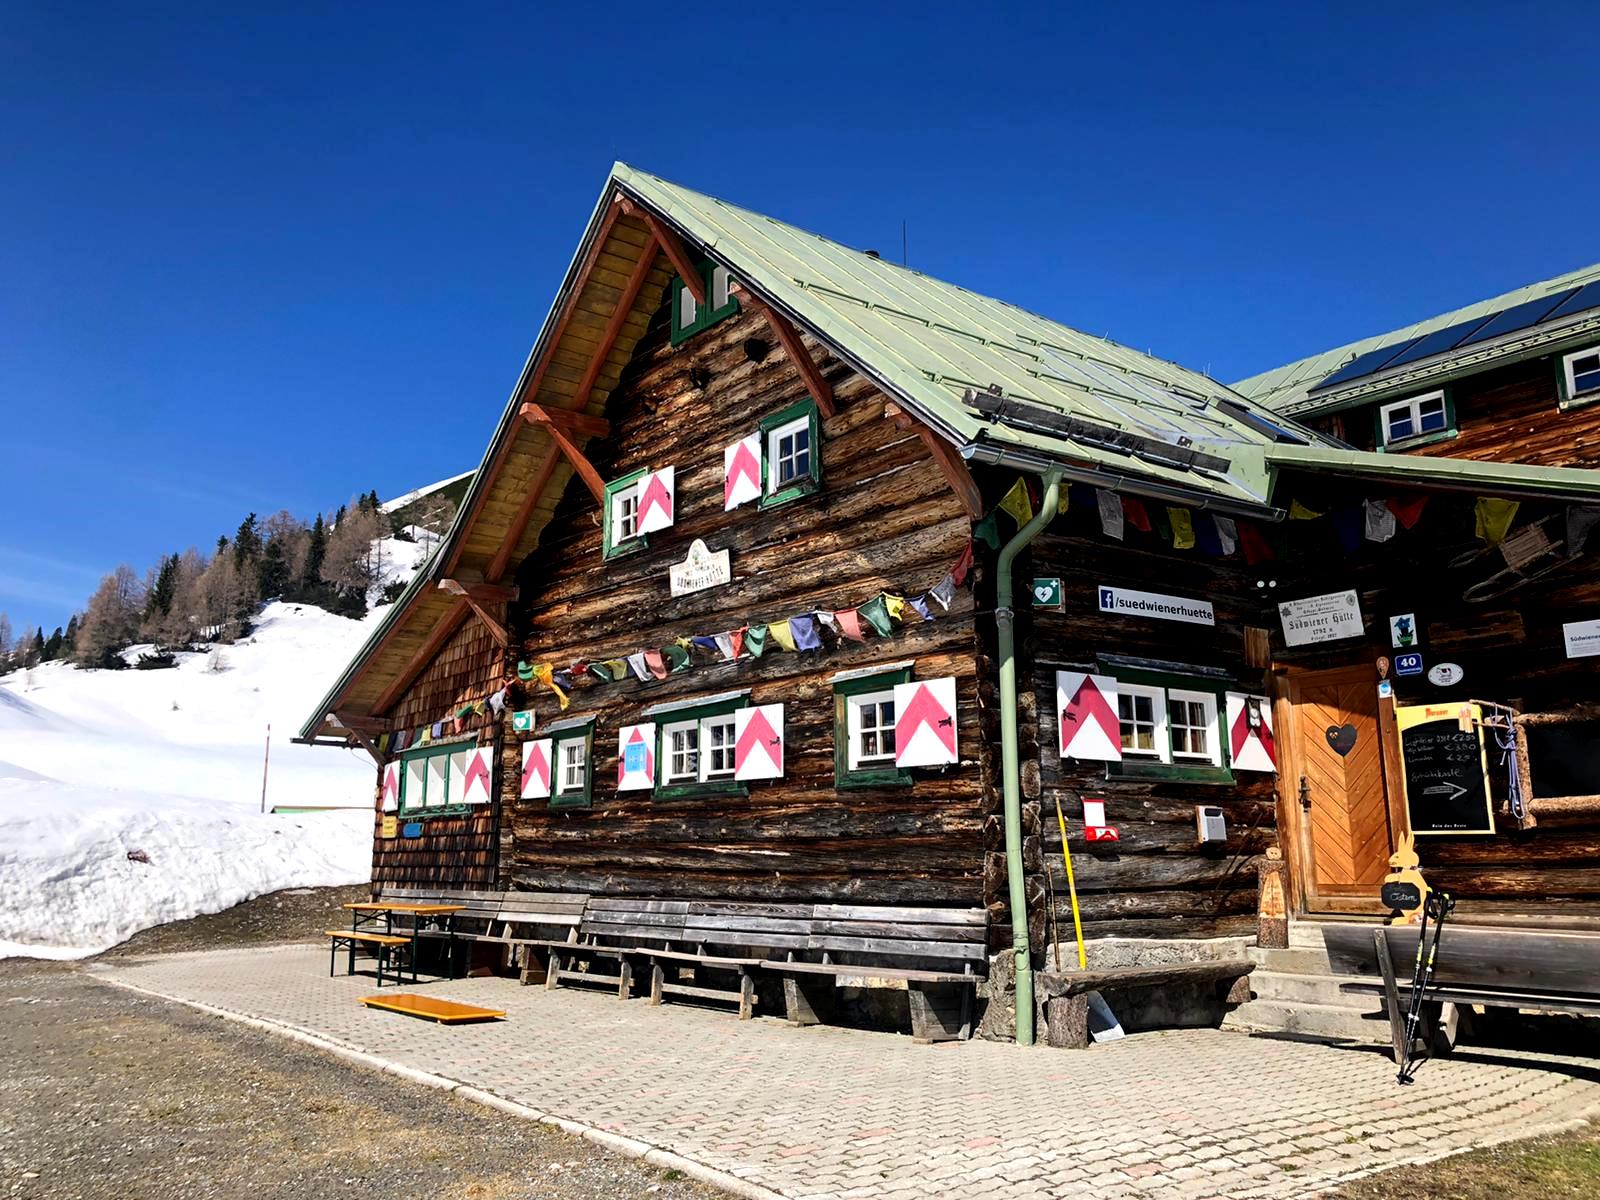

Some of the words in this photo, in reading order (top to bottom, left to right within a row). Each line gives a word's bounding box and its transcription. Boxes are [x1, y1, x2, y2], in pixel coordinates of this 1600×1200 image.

[1115, 597, 1213, 620] /suedwienerhuette
[1289, 617, 1328, 631] Südwiener
[1332, 612, 1354, 625] Hütte
[1400, 657, 1417, 667] 40
